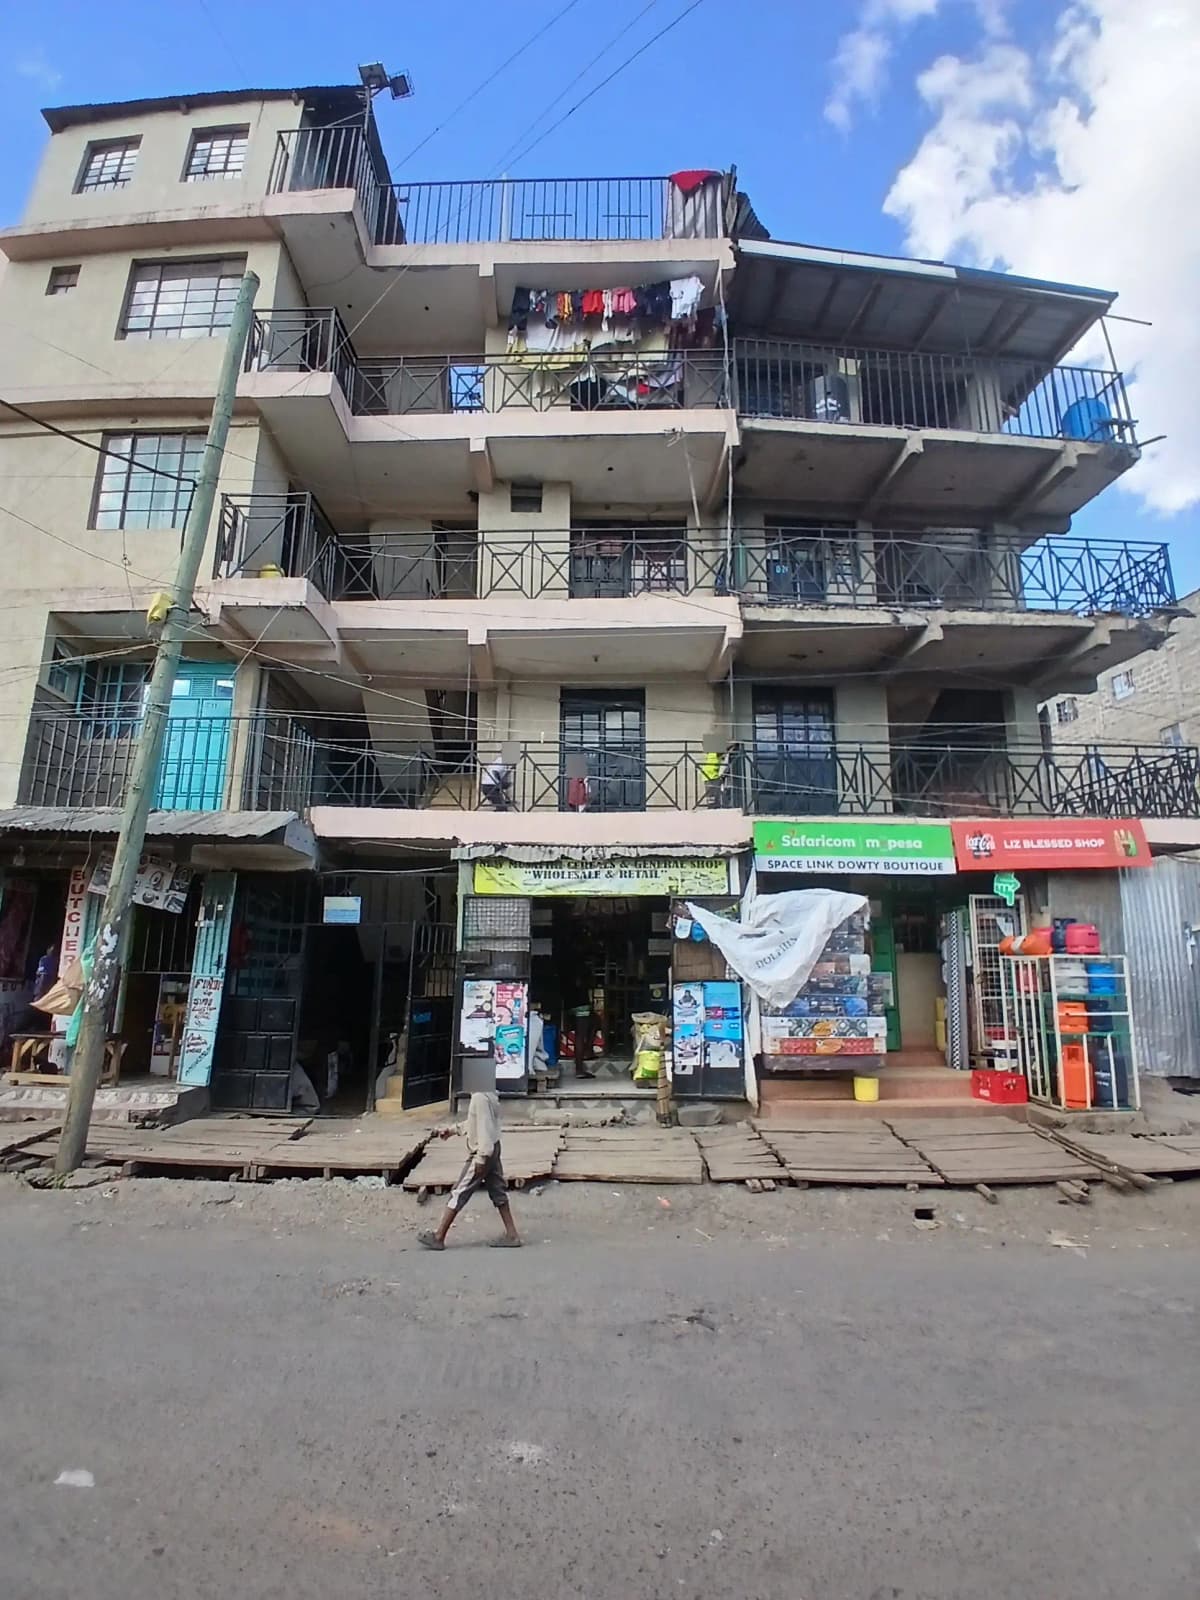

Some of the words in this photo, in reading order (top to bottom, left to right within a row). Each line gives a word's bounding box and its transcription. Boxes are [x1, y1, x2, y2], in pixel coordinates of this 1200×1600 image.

[781, 834, 855, 848] Safaricom
[1003, 839, 1022, 849] LIZ
[1023, 838, 1073, 849] BLESSED
[1075, 838, 1105, 848] SHOP
[690, 859, 722, 869] SHOP
[767, 859, 803, 870] SPACE
[806, 860, 833, 869] LINK
[837, 861, 880, 870] DOWTY
[884, 861, 944, 871] BOUTIQUE
[604, 870, 616, 879] &
